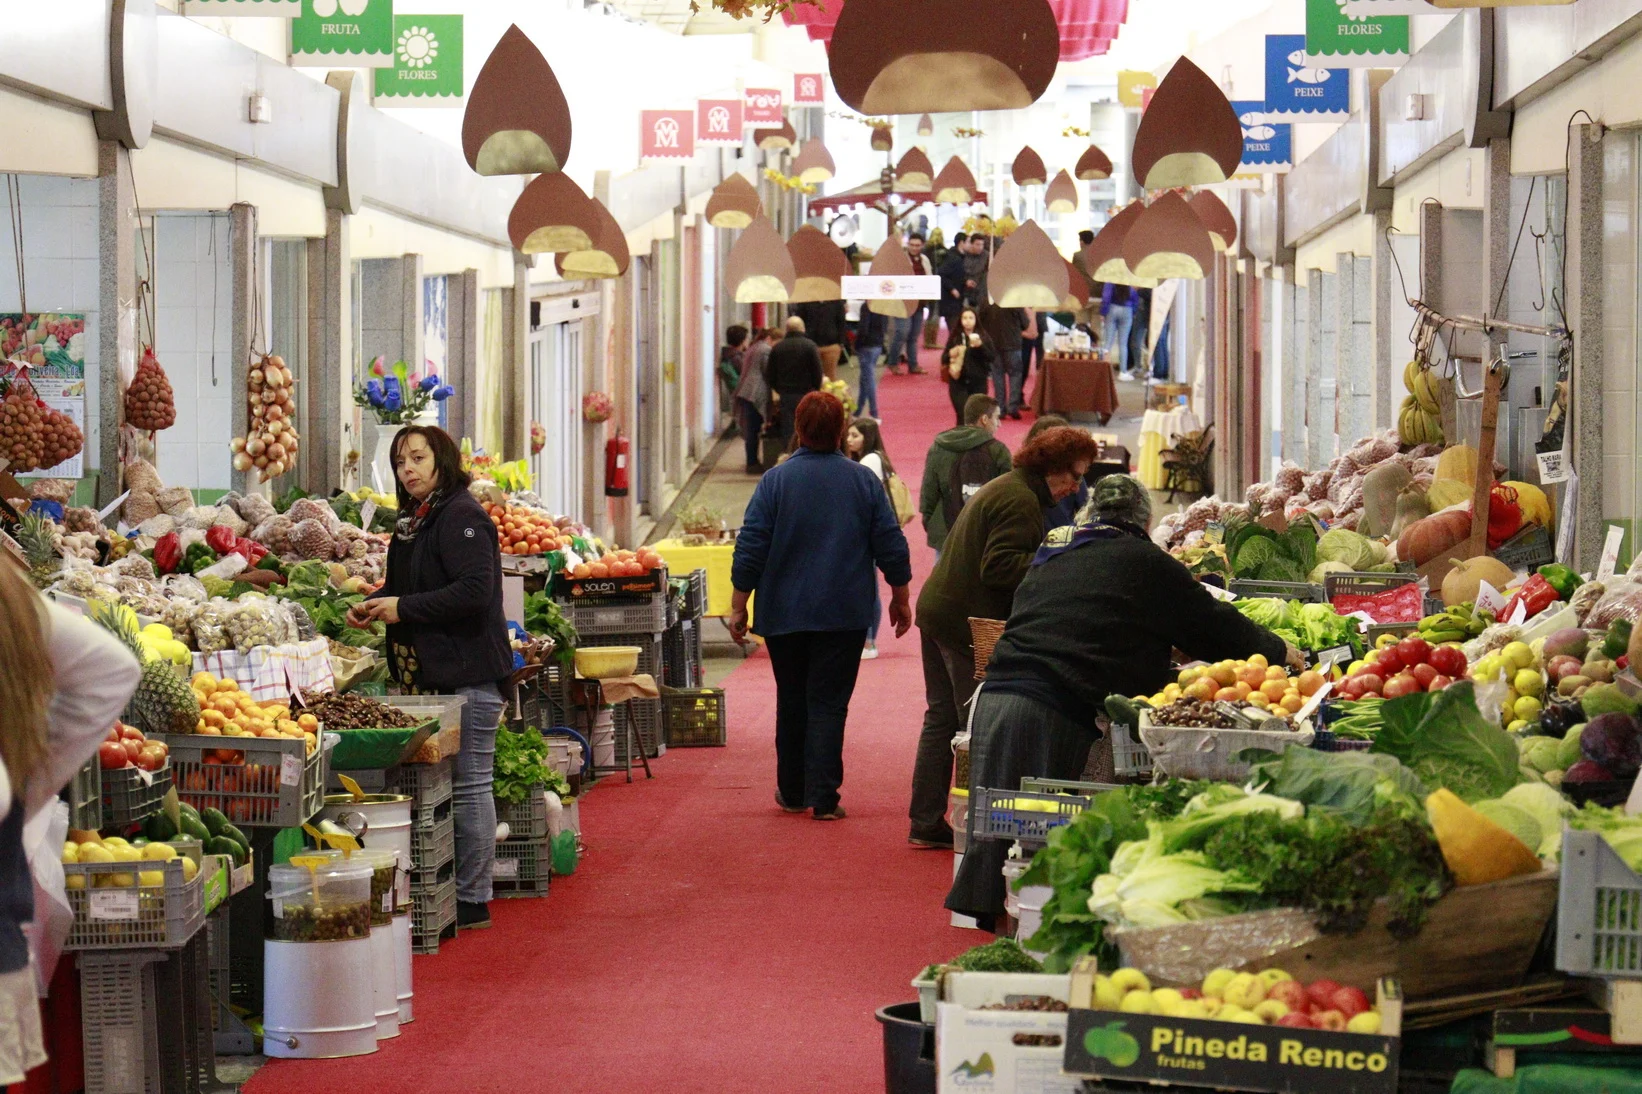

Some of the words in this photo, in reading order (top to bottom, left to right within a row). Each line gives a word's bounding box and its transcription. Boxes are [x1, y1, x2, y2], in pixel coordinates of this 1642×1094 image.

[321, 24, 360, 35] FRUTA
[1337, 24, 1382, 35] FLORES
[398, 70, 437, 80] FLORES
[1294, 87, 1324, 97] PEIXE
[1245, 143, 1270, 152] PEIXE
[1151, 1027, 1268, 1062] Pineda
[1279, 1039, 1388, 1073] Renco
[1156, 1054, 1206, 1071] frutas
